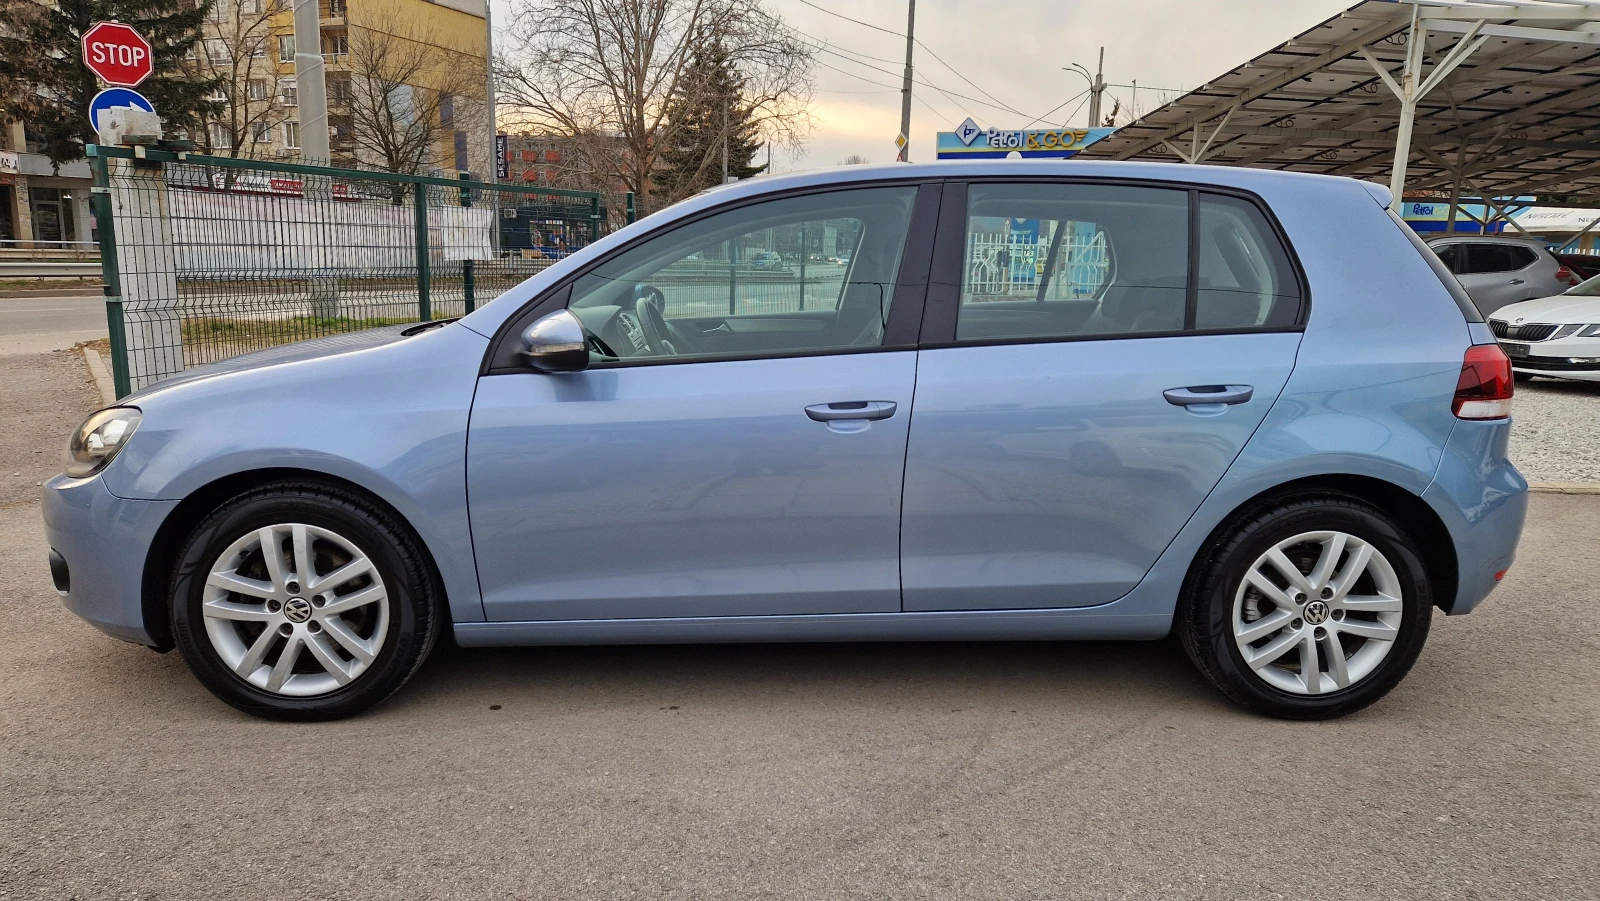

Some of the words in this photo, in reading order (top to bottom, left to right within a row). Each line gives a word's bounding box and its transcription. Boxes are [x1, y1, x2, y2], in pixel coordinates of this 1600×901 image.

[91, 41, 145, 68] STOP
[986, 127, 1024, 148] Petrol
[497, 136, 505, 178] SESAME
[1413, 203, 1434, 216] Petrol
[285, 598, 311, 622] VW
[1304, 601, 1328, 624] VW
